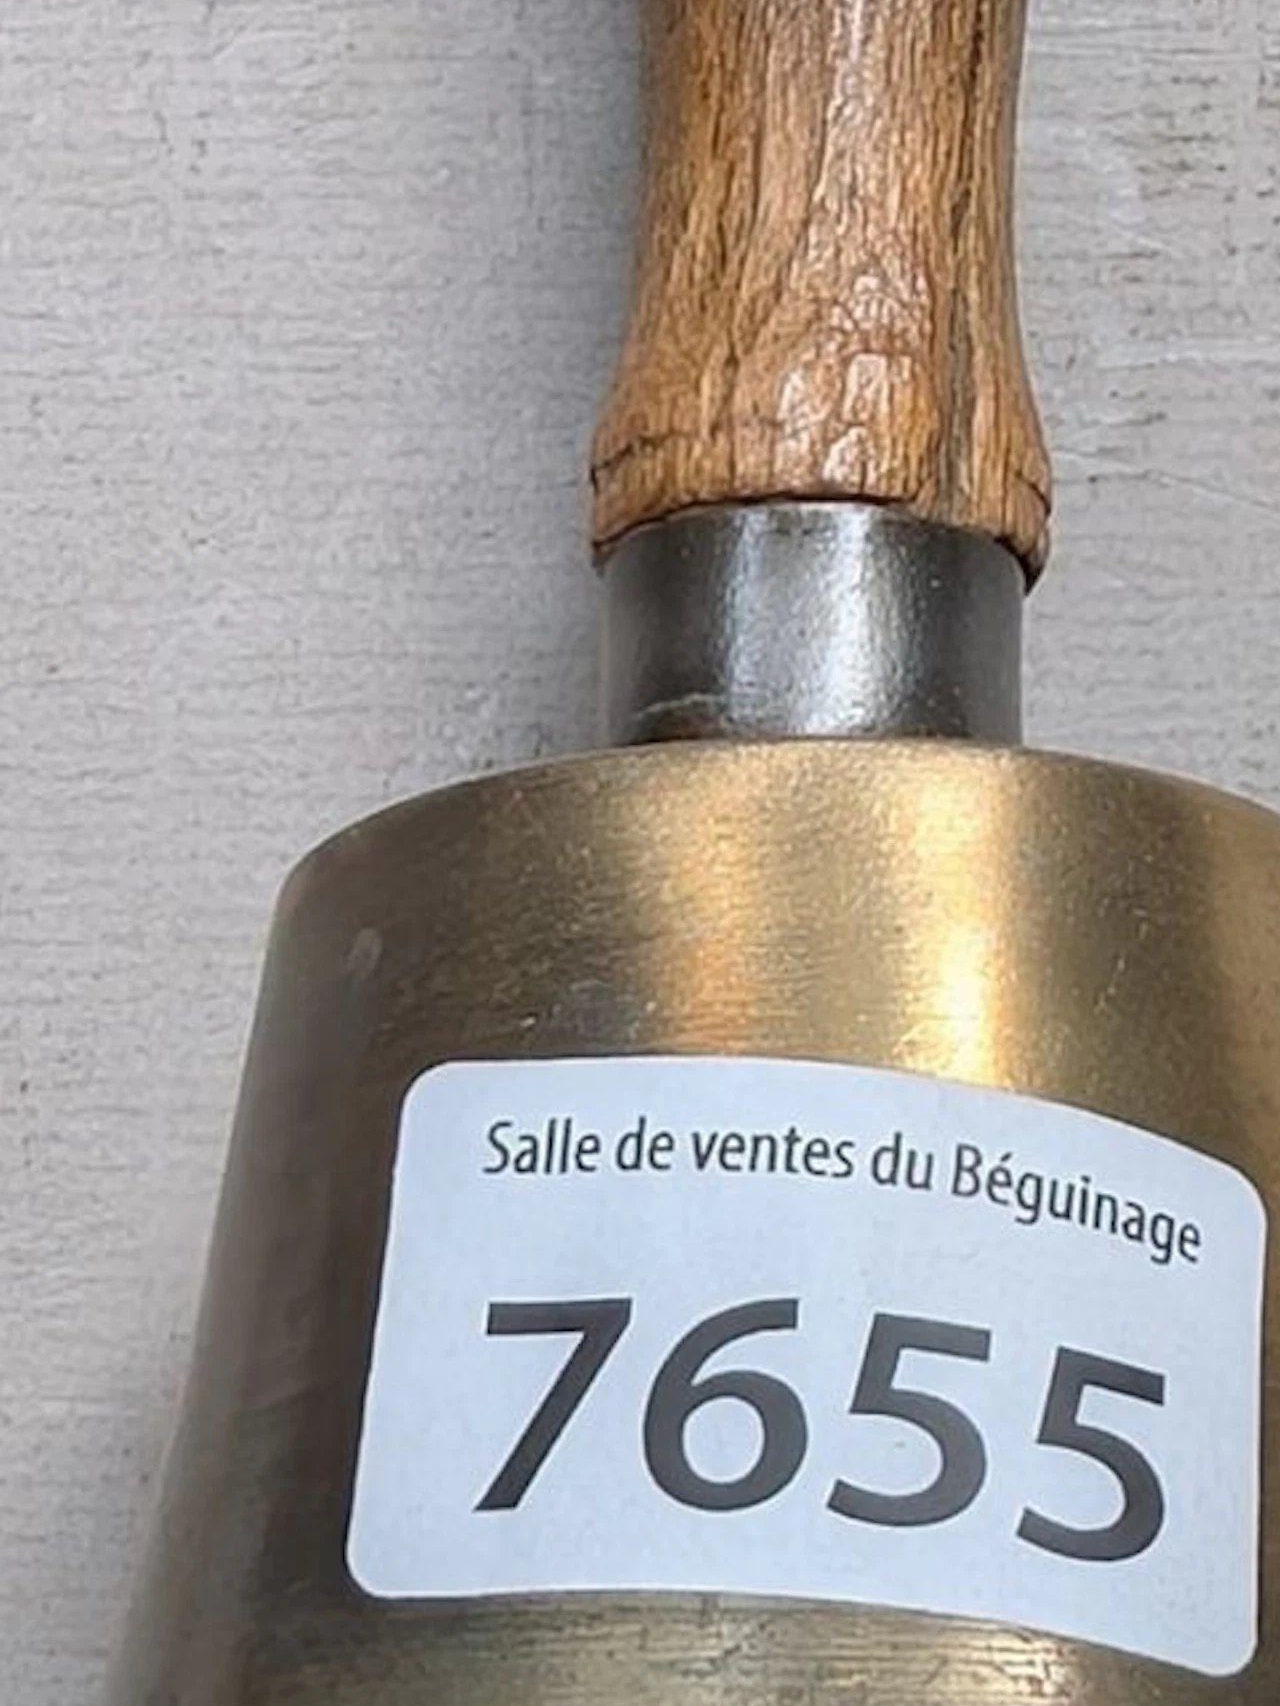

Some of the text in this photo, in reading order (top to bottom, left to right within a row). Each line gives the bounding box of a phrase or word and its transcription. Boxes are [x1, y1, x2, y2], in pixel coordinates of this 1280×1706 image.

[482, 1116, 1202, 1265] Salle de ventes du Béguinage
[473, 1297, 1167, 1563] 7655
